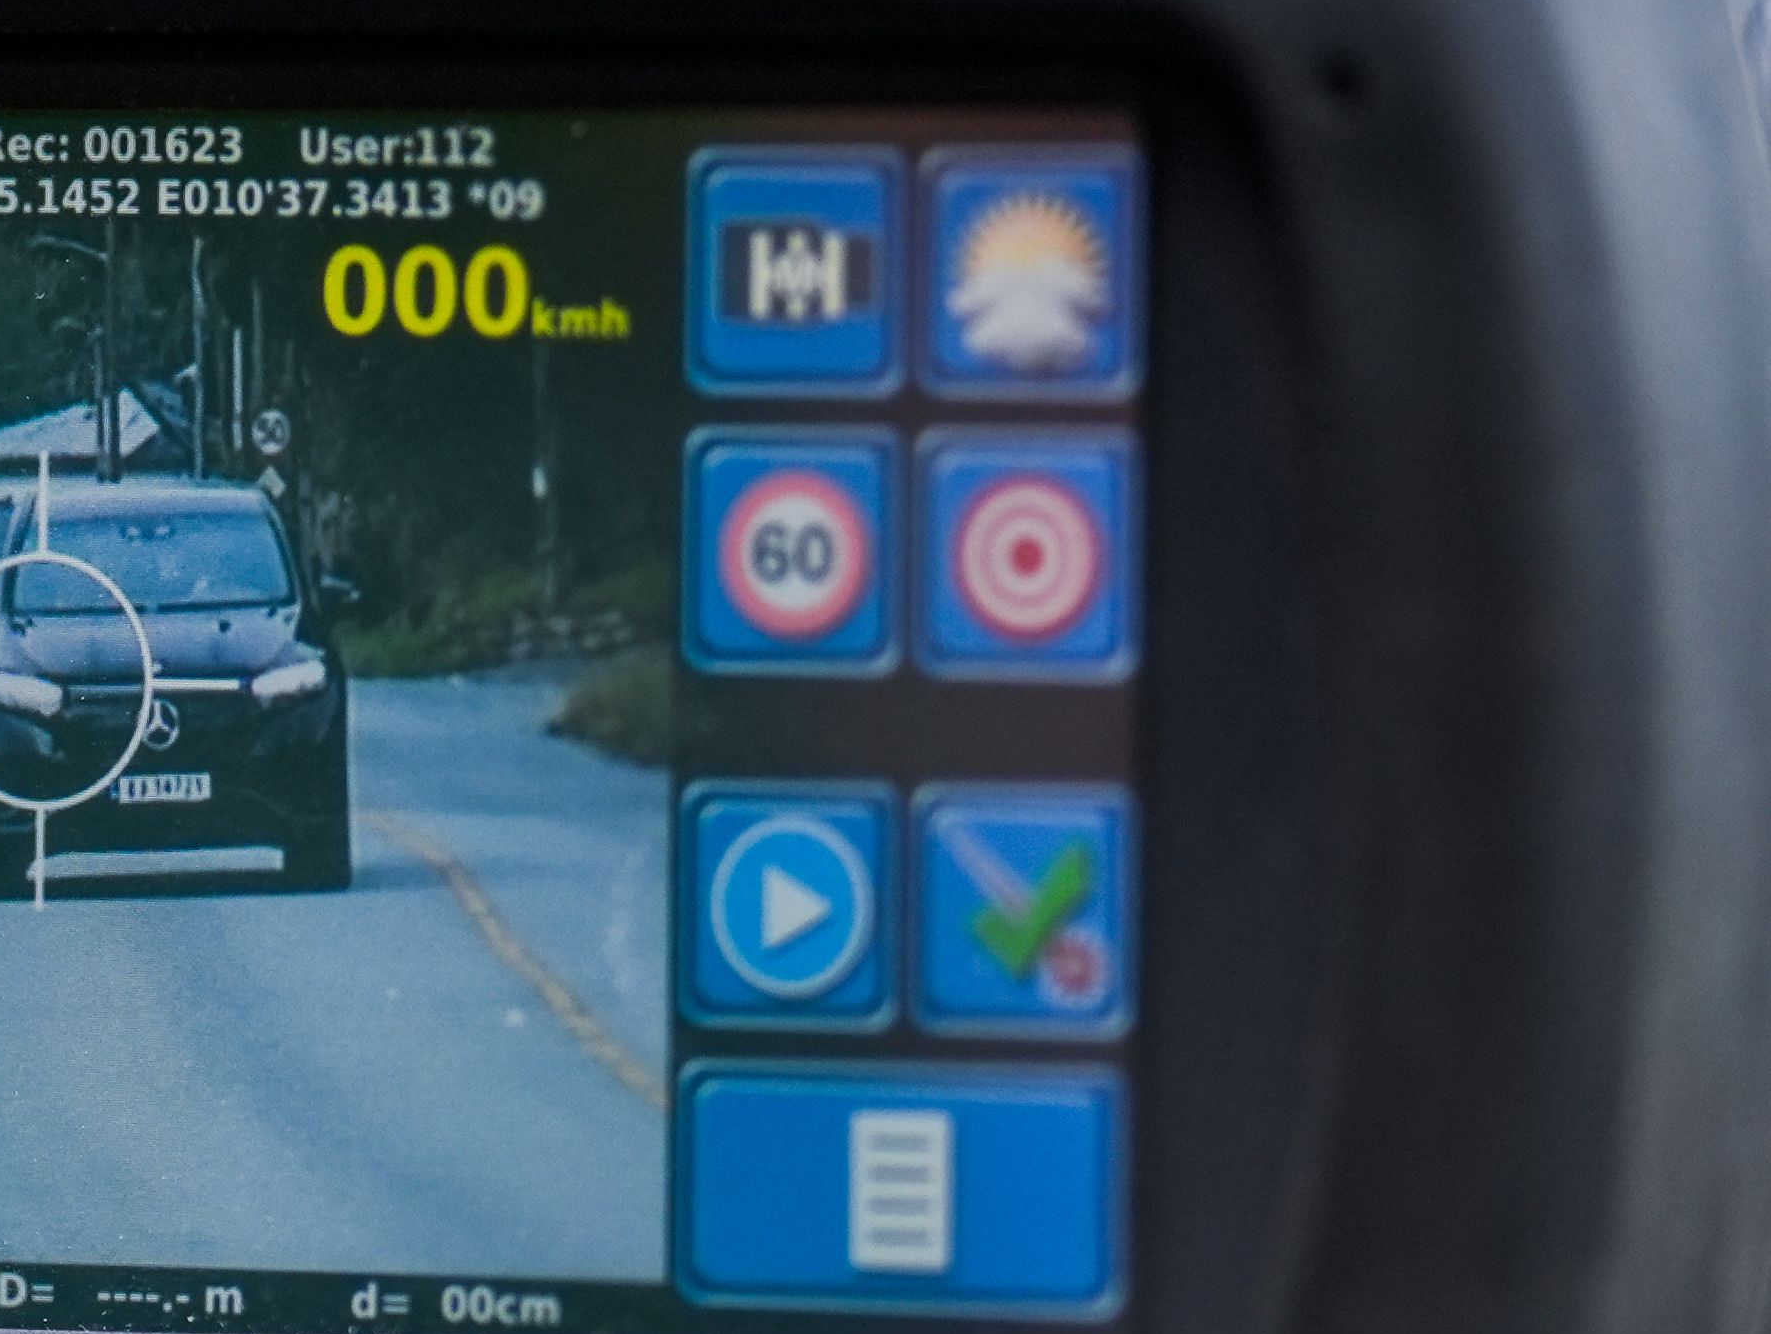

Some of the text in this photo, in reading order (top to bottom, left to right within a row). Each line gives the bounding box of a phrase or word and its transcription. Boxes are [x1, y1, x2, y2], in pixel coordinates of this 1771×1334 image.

[82, 126, 244, 164] 001623
[298, 127, 496, 166] User:112
[751, 520, 835, 585] 60
[204, 1284, 244, 1315] m
[351, 1281, 412, 1320] d=
[440, 1285, 562, 1326] 00cm
